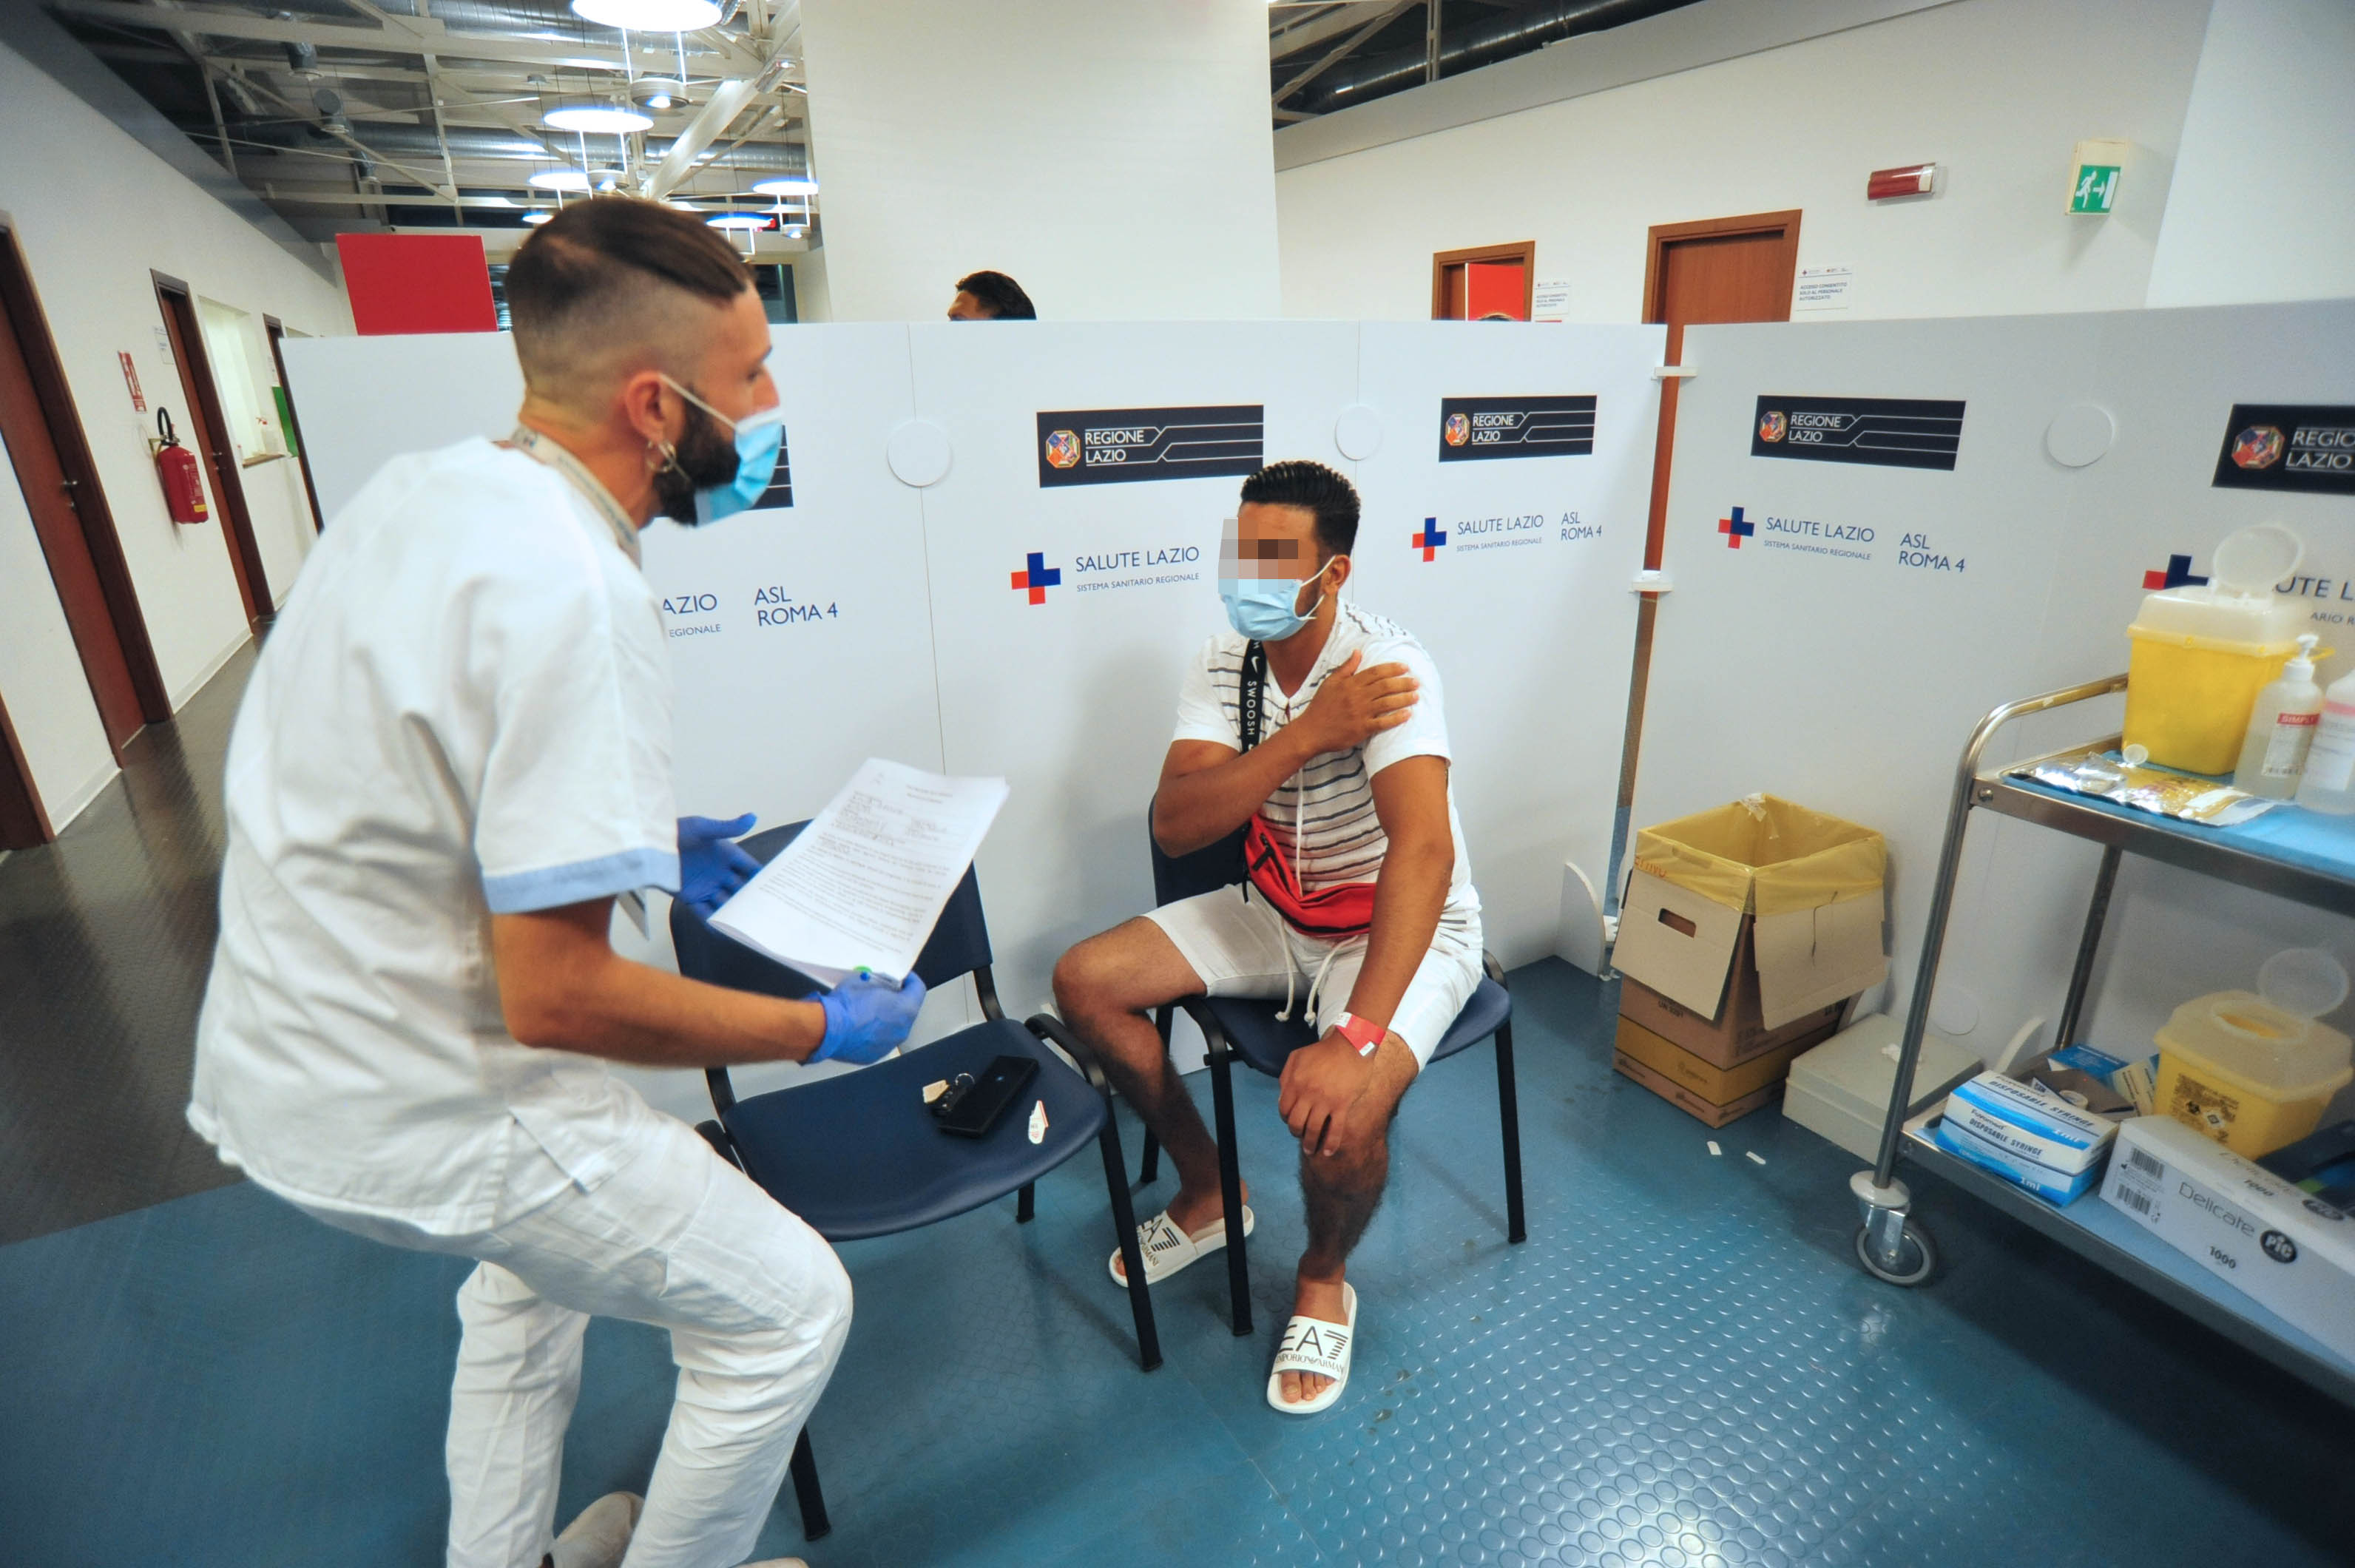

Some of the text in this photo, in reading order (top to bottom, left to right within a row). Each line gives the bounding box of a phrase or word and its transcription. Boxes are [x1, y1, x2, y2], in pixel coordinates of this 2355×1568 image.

[1473, 415, 1514, 427] REGIONE
[1790, 414, 1841, 428] REGIONE
[1085, 430, 1144, 445] REGIONE
[1471, 430, 1501, 442] LAZIO
[1788, 430, 1822, 442] LAZIO
[1085, 449, 1126, 464] LAZIO
[2285, 451, 2353, 469] LAZIO
[1457, 515, 1544, 535] SALUTE LAZIO
[1561, 511, 1581, 526] ASL
[1561, 525, 1602, 541] ROMA 4
[1766, 517, 1875, 542] SALUTE LAZIO
[1456, 537, 1543, 552] SISTEMA SANITARIO REGIONALE
[1763, 539, 1872, 561] SISTEMA SANITARIO REGIONALE
[1899, 532, 1930, 550] ASL
[1075, 546, 1200, 572] SALUTE LAZIO
[1898, 550, 1965, 572] ROMA 4
[1076, 572, 1200, 592] SISTEMA SANITARIO REGIONALE
[2275, 576, 2331, 598] UTE
[663, 593, 717, 615] AZIO
[754, 586, 792, 606] ASL
[757, 601, 839, 626] ROMA 4
[669, 624, 722, 638] EGIONALE
[1246, 680, 1257, 735] SWOOSH
[1989, 1080, 2048, 1107] DISPOSABLE
[2049, 1106, 2095, 1127] SYRINGE
[1969, 1117, 2009, 1143] DISPOSABLE
[2010, 1138, 2044, 1157] SYRINGE
[2178, 1181, 2257, 1237] Delicate
[2209, 1245, 2237, 1270] 1000
